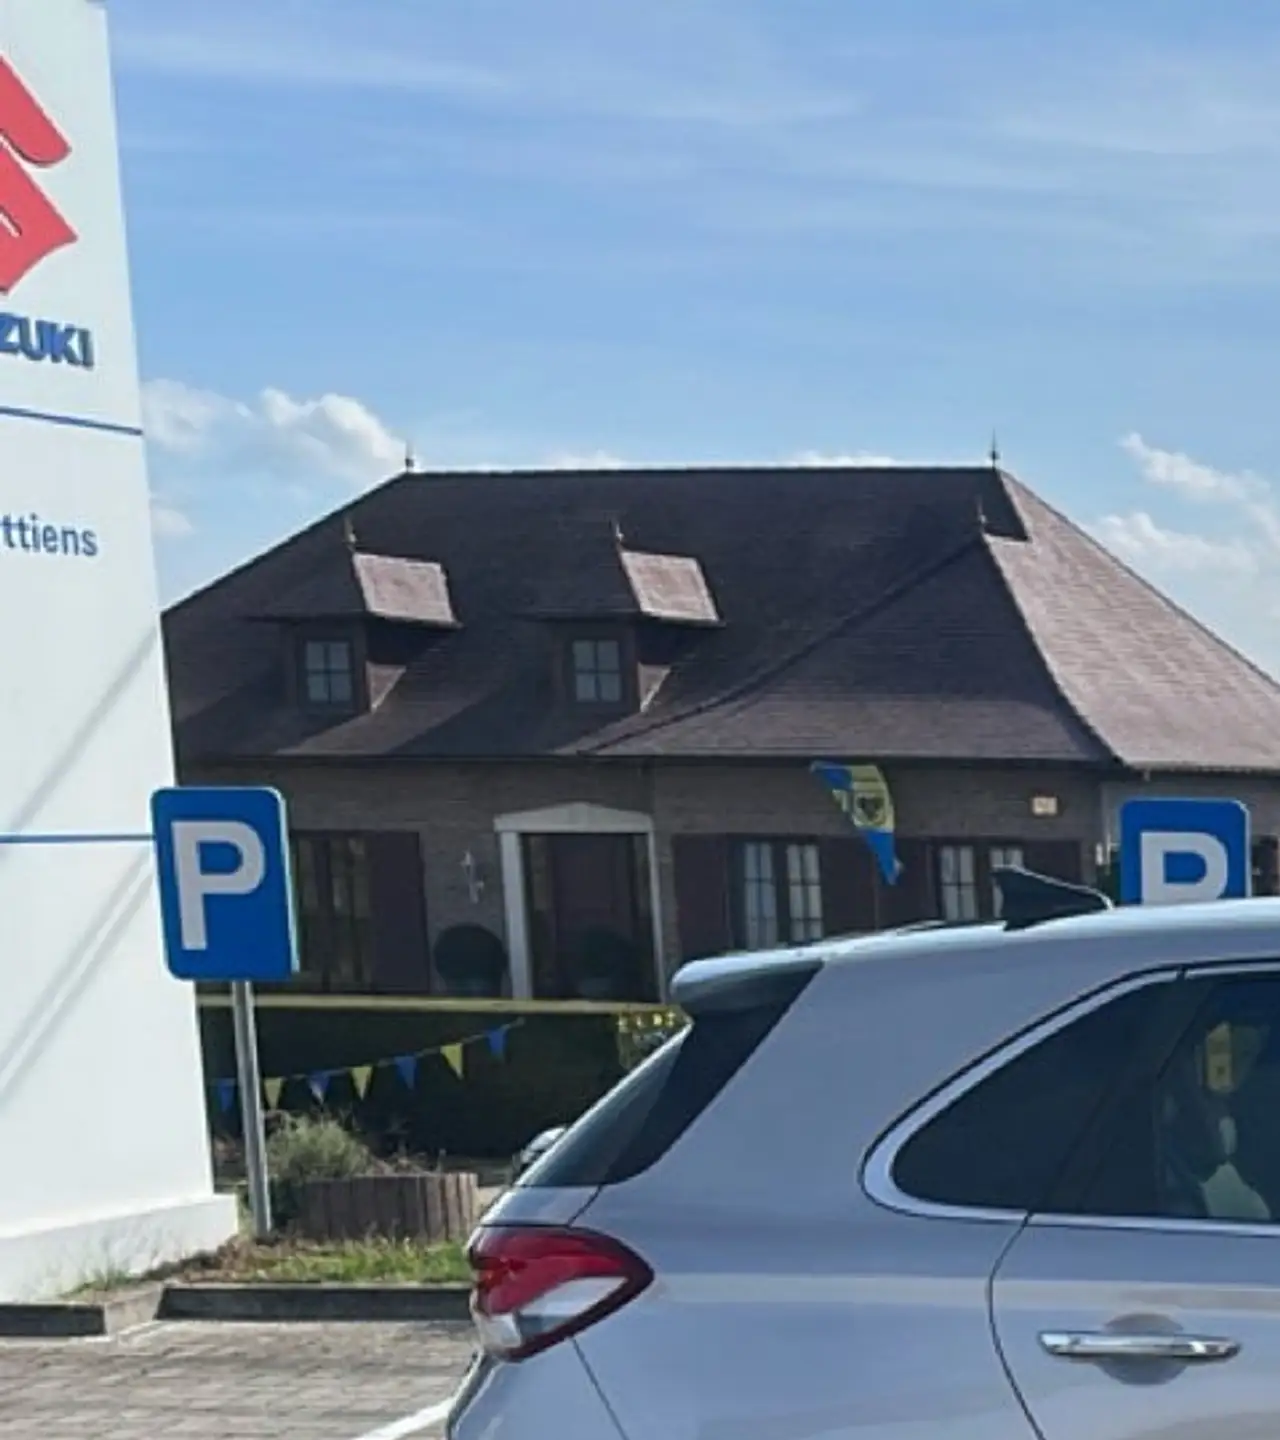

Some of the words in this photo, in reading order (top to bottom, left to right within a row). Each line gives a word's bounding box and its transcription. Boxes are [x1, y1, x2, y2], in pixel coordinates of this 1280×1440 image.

[0, 513, 98, 556] ttiens
[171, 820, 265, 950] P
[1141, 831, 1228, 907] P
